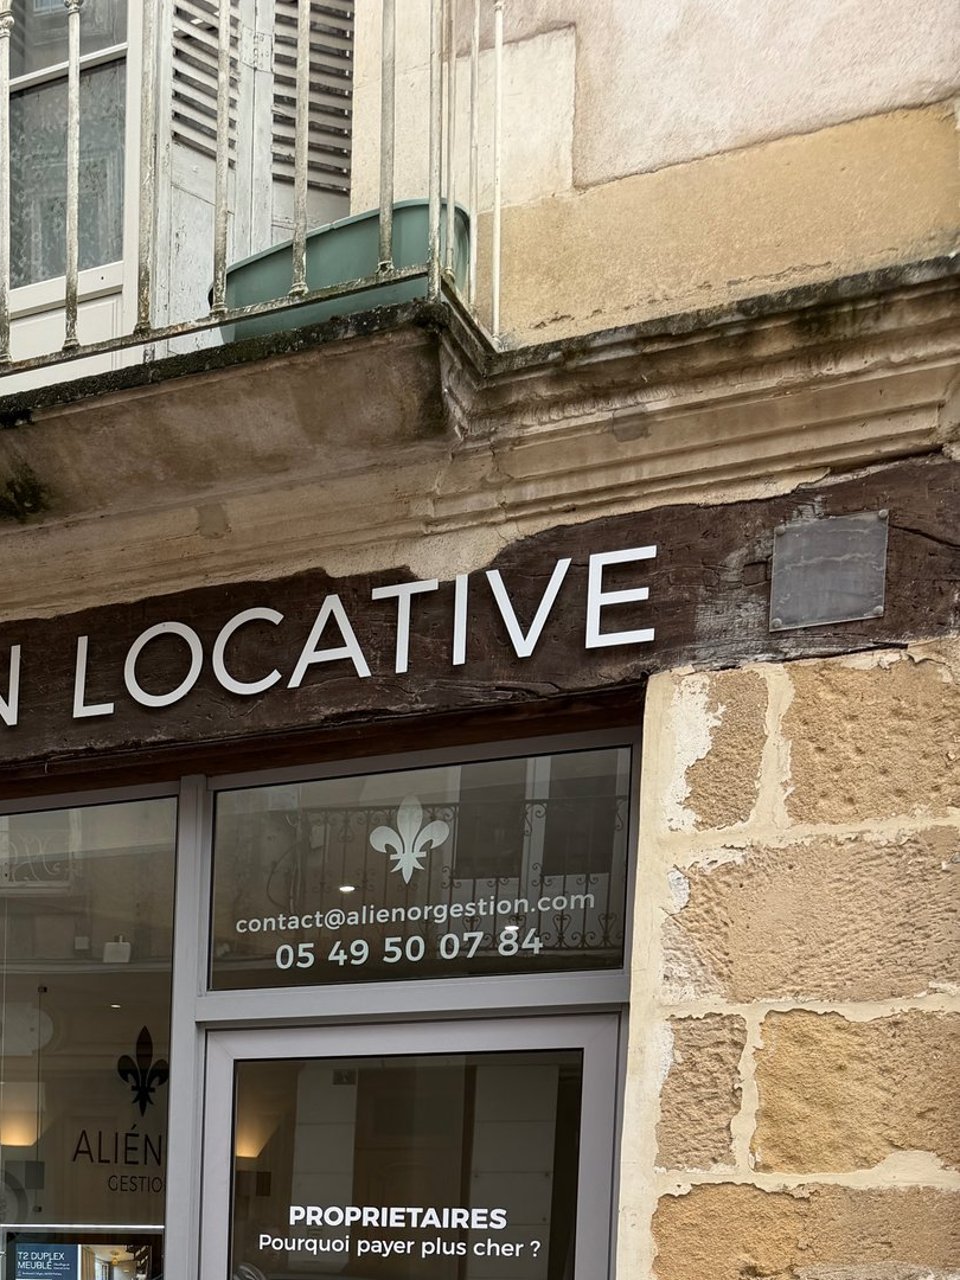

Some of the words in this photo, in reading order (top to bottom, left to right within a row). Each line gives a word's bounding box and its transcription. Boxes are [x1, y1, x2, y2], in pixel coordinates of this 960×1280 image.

[71, 545, 658, 720] LOCATIVE
[235, 891, 596, 935] contact@alienorgestion.com
[275, 942, 315, 969] 05
[327, 940, 370, 967] 49
[382, 936, 426, 963] 50
[439, 931, 484, 959] 07
[497, 928, 544, 956] 84
[289, 1205, 508, 1231] PROPRIETAIRES
[17, 1252, 29, 1260] T2
[30, 1252, 65, 1261] DUPLEX
[258, 1234, 350, 1256] Pourquoi
[356, 1238, 415, 1258] payer
[421, 1237, 467, 1258] plus
[473, 1238, 524, 1257] cher
[530, 1240, 541, 1258] ?
[17, 1259, 53, 1270] MEUBLÉ
